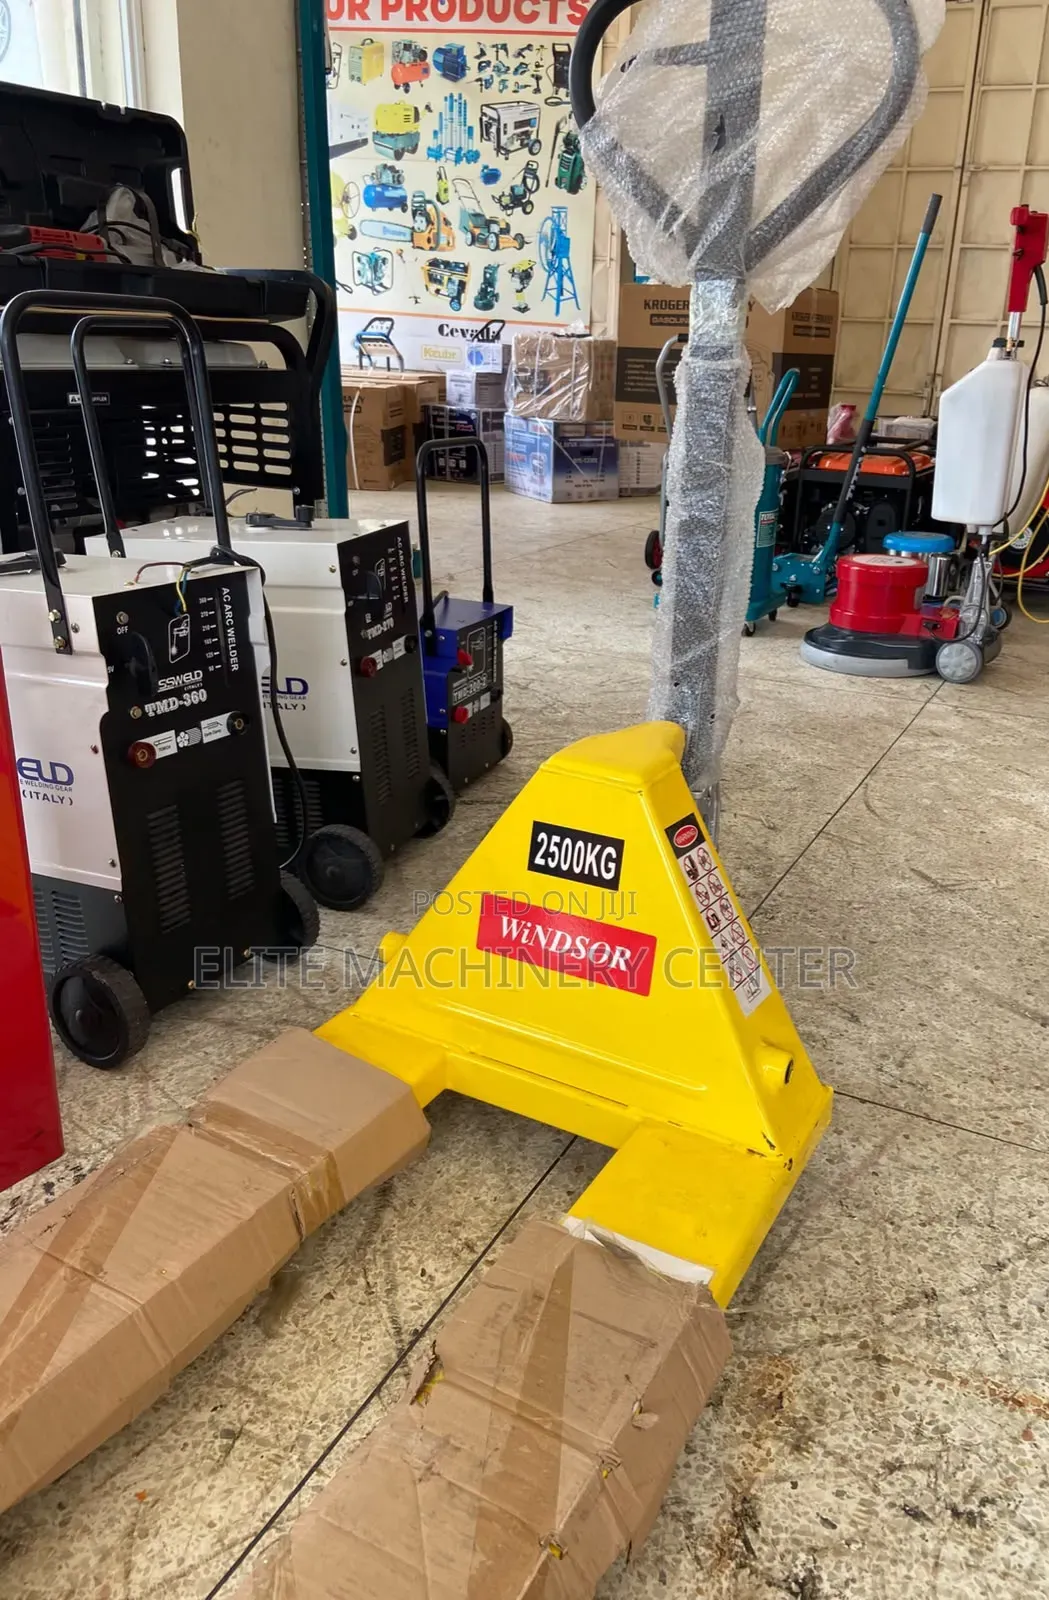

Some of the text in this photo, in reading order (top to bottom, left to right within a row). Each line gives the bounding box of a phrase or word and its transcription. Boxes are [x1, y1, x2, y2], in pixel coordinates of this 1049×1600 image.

[381, 0, 589, 25] PRODUCTS
[644, 299, 689, 310] KROGER
[116, 626, 129, 635] OFF
[221, 587, 239, 672] AC ARC WELDER
[144, 689, 207, 717] TMD-360
[25, 780, 54, 790] WELDING
[56, 784, 73, 792] GEAR
[533, 832, 617, 881] 2500KG
